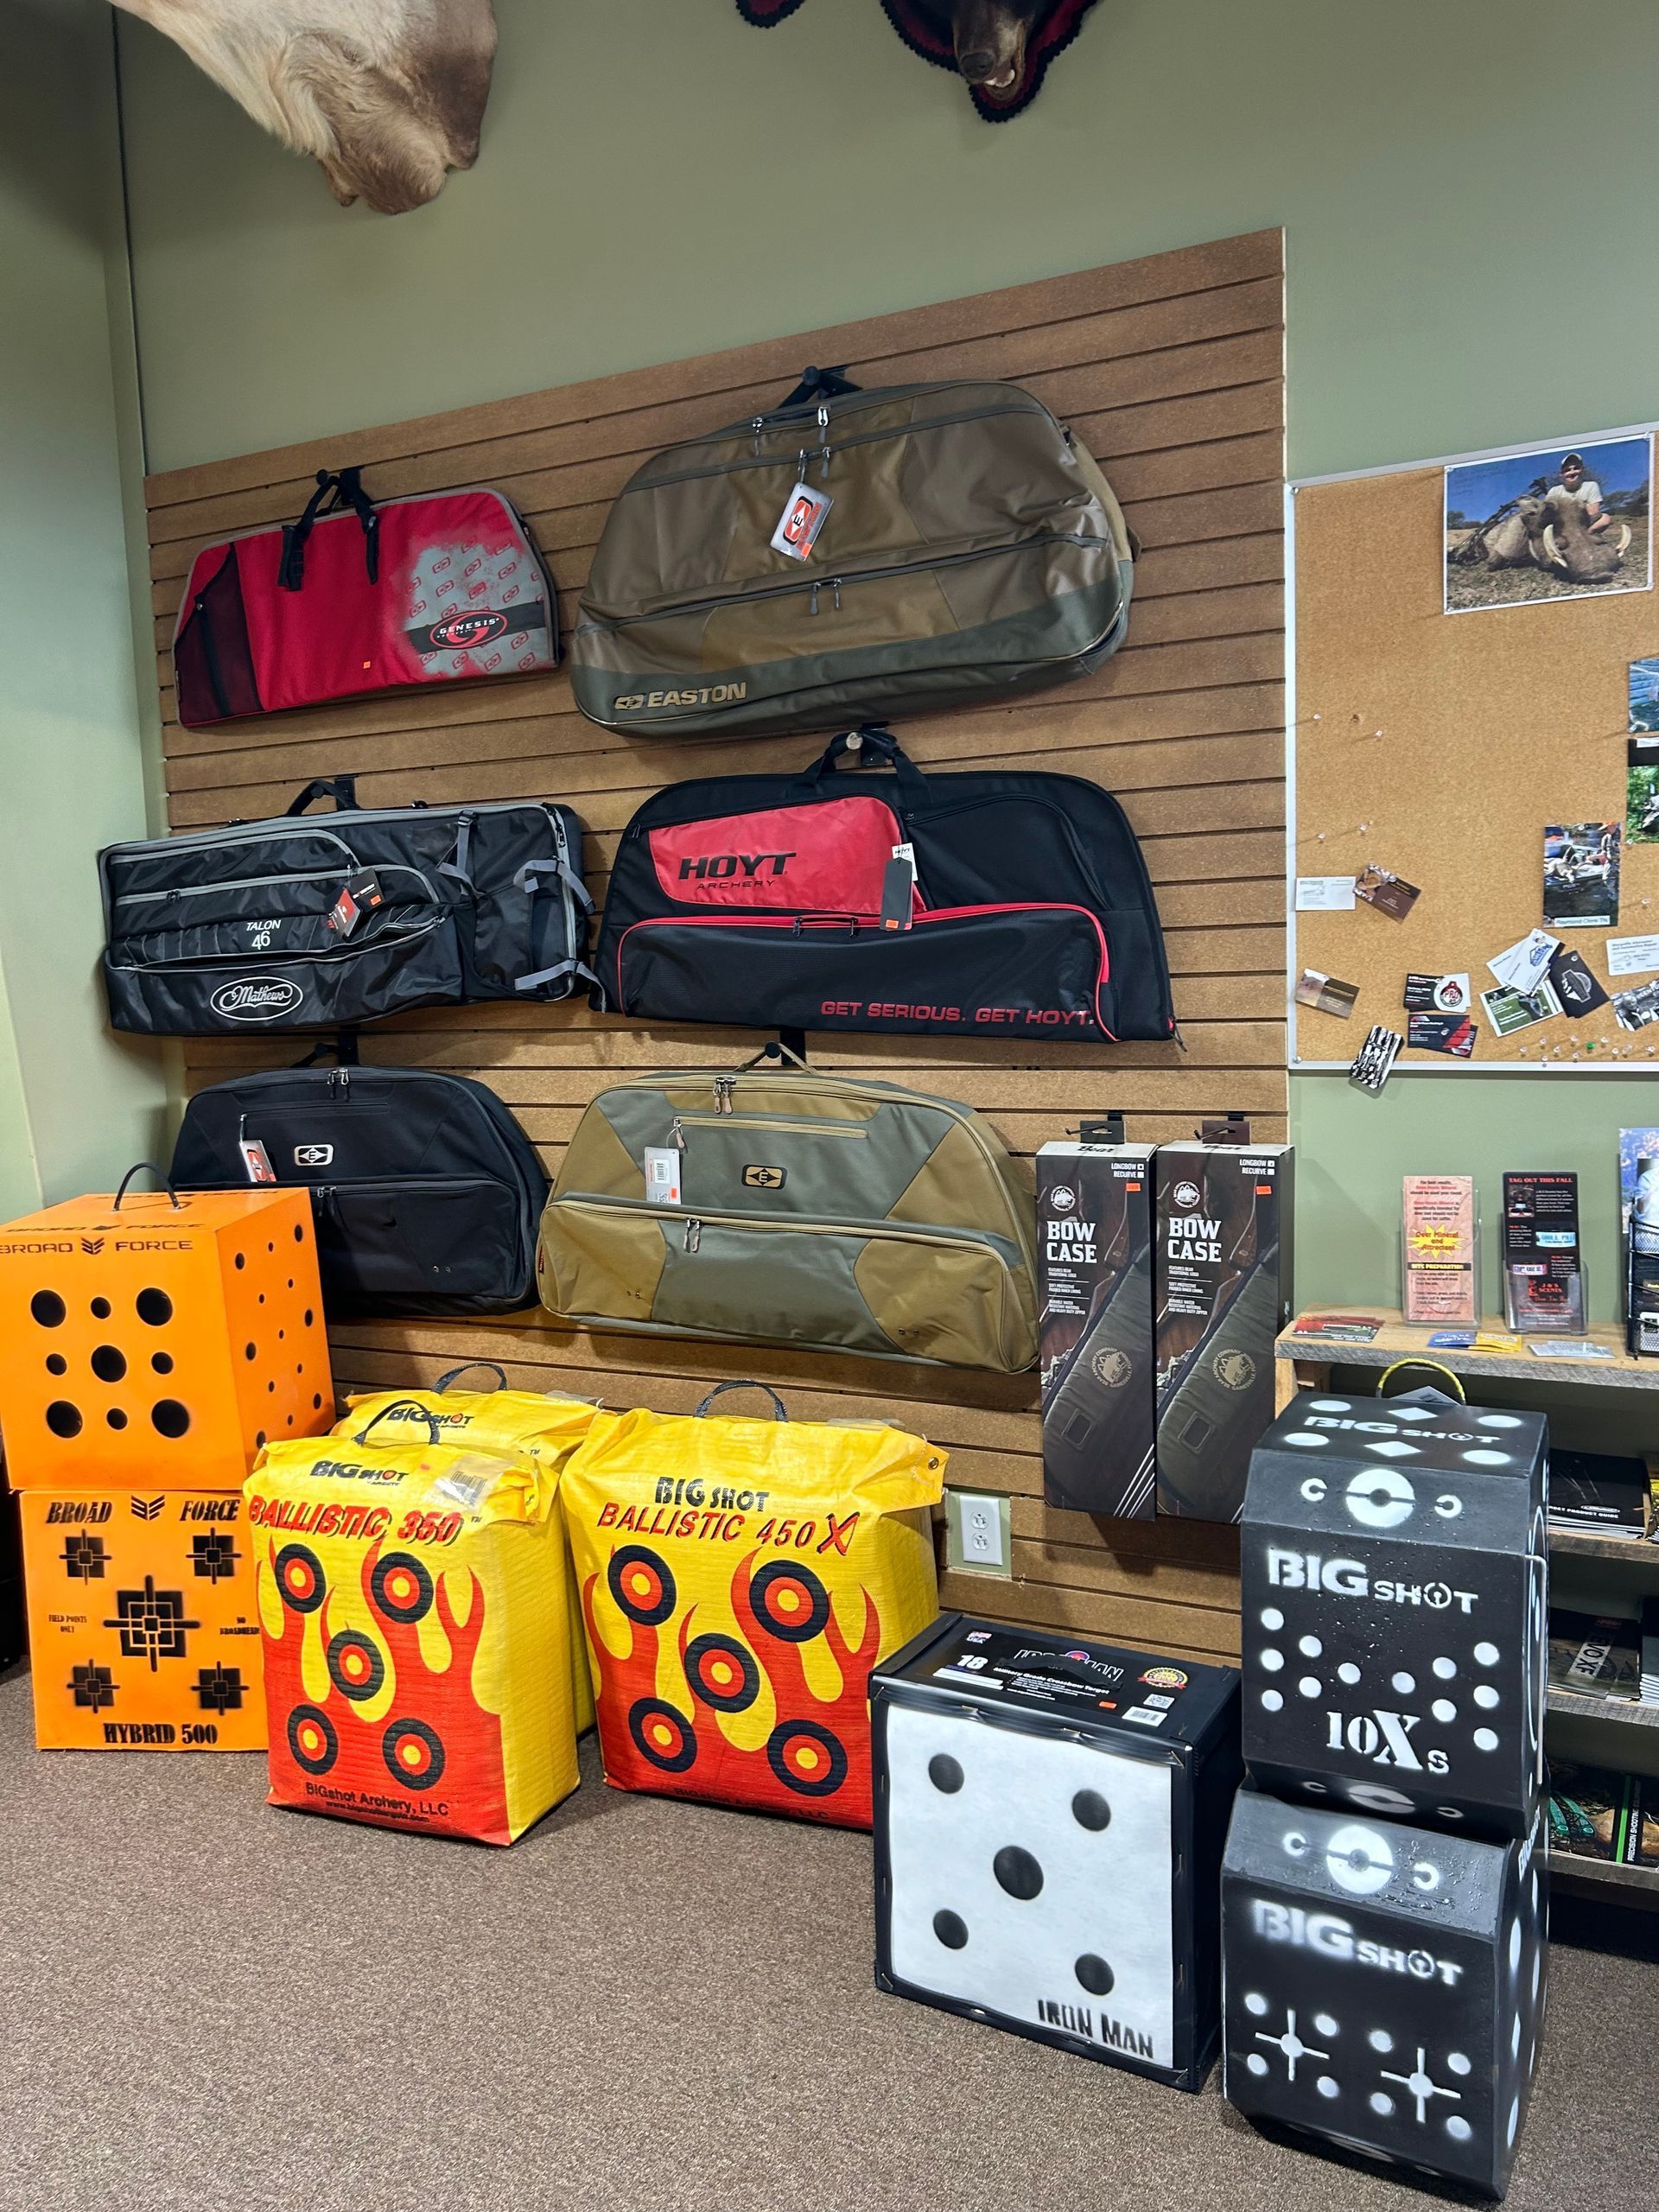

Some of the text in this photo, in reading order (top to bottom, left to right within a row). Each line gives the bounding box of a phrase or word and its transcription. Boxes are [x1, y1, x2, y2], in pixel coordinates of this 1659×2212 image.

[439, 618, 497, 634] GENESIS
[647, 682, 747, 708] EASTON
[677, 852, 797, 880] HOYT
[696, 879, 776, 891] ARCHERY
[246, 919, 282, 931] TALON
[251, 931, 271, 950] 46
[219, 983, 294, 1009] Mathews
[821, 1001, 1095, 1026] GET SERIOUS. GET HOYT.
[759, 1172, 769, 1183] E
[1046, 1221, 1096, 1242] BOW
[1168, 1217, 1222, 1239] BOW
[0, 1240, 193, 1254] BROAD FORCE
[1046, 1242, 1097, 1264] CASE
[1167, 1239, 1222, 1262] CASE
[1303, 1415, 1399, 1434] BIG
[308, 1459, 410, 1482] BIG SHOT
[654, 1476, 770, 1513] BIG SHOT
[46, 1499, 240, 1524] BROAD FORCE
[248, 1494, 393, 1541] BALLISTIC
[596, 1502, 746, 1541] BALLISTIC
[1268, 1547, 1479, 1614] BIG SHOT
[48, 1614, 87, 1624] FIELD POINTS
[957, 1655, 988, 1669] 18
[993, 1667, 1023, 1677] Military
[1023, 1672, 1046, 1681] Grade
[1046, 1677, 1084, 1690] Crossbow
[1084, 1685, 1110, 1694] Target
[103, 1723, 218, 1745] HYBRID 500
[305, 1782, 449, 1816] BIGshot Archery, LLC
[1252, 1899, 1464, 1986] BIG SHOT
[1100, 2012, 1154, 2060] MAN
